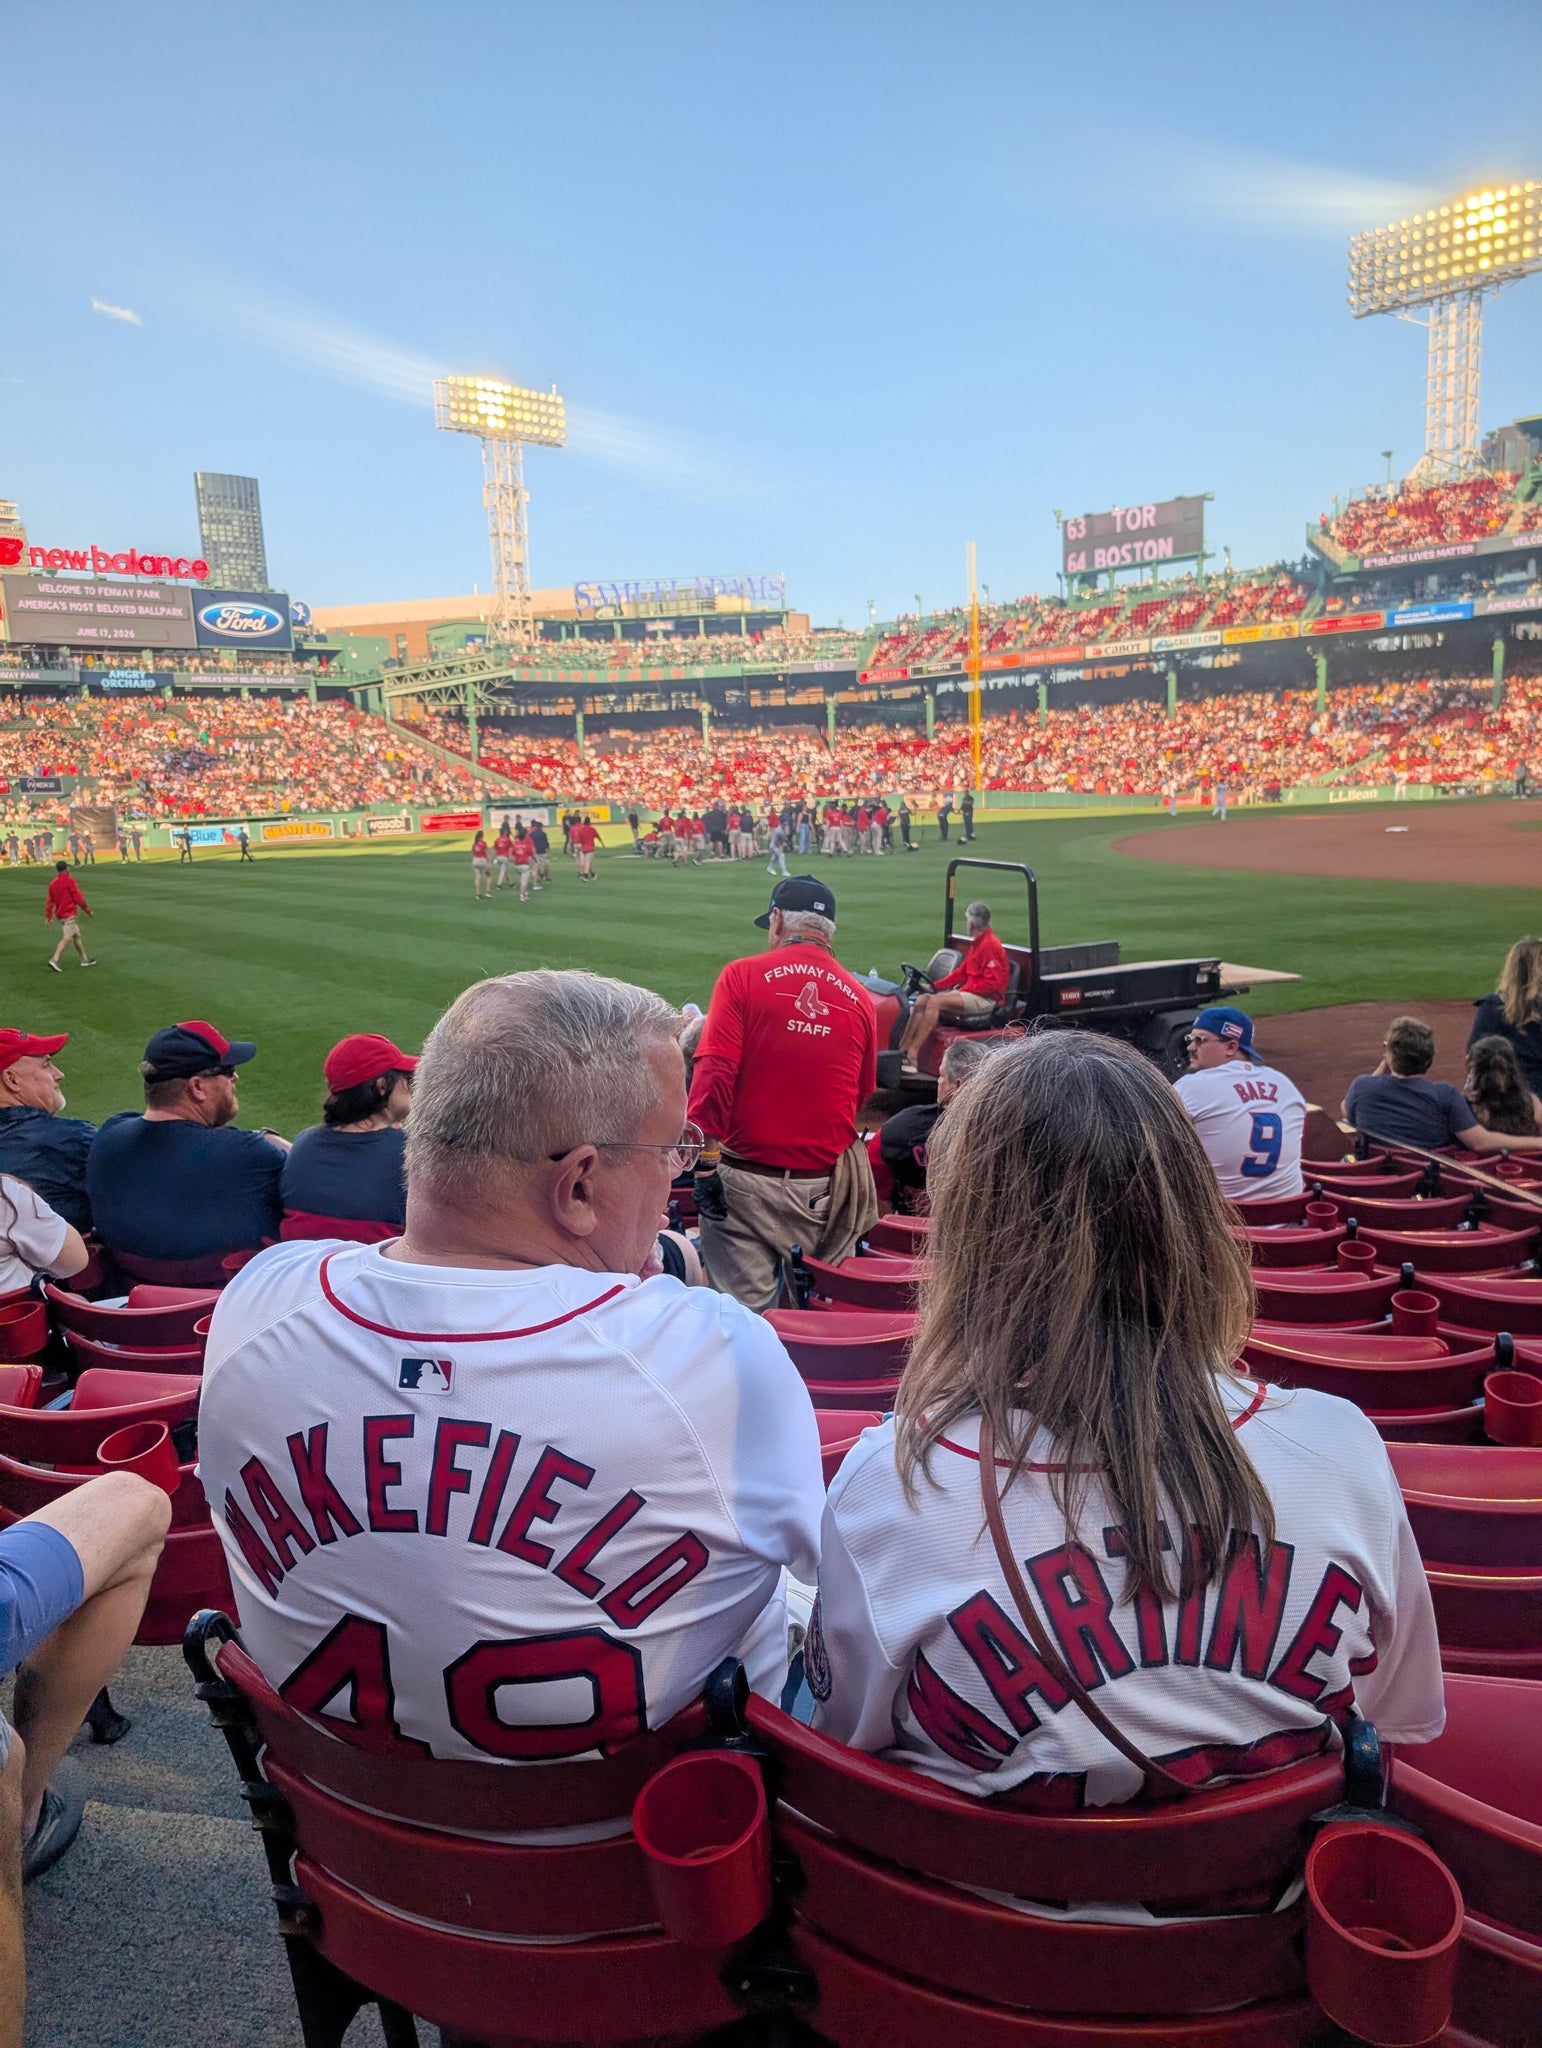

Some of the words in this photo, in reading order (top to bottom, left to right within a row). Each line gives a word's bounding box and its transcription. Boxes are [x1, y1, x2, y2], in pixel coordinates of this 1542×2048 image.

[1067, 517, 1086, 540] 63
[1111, 504, 1156, 533] TOR
[30, 546, 88, 571] new
[91, 544, 209, 580] balance
[1067, 551, 1086, 573] 64
[1094, 536, 1173, 569] BOSTON
[1379, 554, 1408, 567] BLACK
[1409, 549, 1435, 561] LIVES
[1436, 544, 1475, 558] MATTER
[38, 583, 81, 596] WELCOME
[84, 587, 96, 596] TO
[98, 588, 135, 597] FENWAY
[137, 590, 161, 600] PARK
[18, 599, 68, 612] AMERICA'S
[69, 602, 94, 613] MOST
[97, 603, 137, 615] BELOVED
[139, 605, 184, 617] BALLPARK
[216, 607, 268, 631] Ford
[76, 628, 98, 637] JUNE
[100, 628, 112, 639] 17,
[113, 629, 135, 639] 2026
[101, 678, 156, 689] ORCHARD
[109, 670, 146, 680] ANGRY
[764, 963, 824, 983] FENWAY
[826, 971, 859, 1004] PARK
[786, 1019, 832, 1037] STAFF
[1233, 1081, 1278, 1104] BAEZ
[1240, 1111, 1283, 1177] 9
